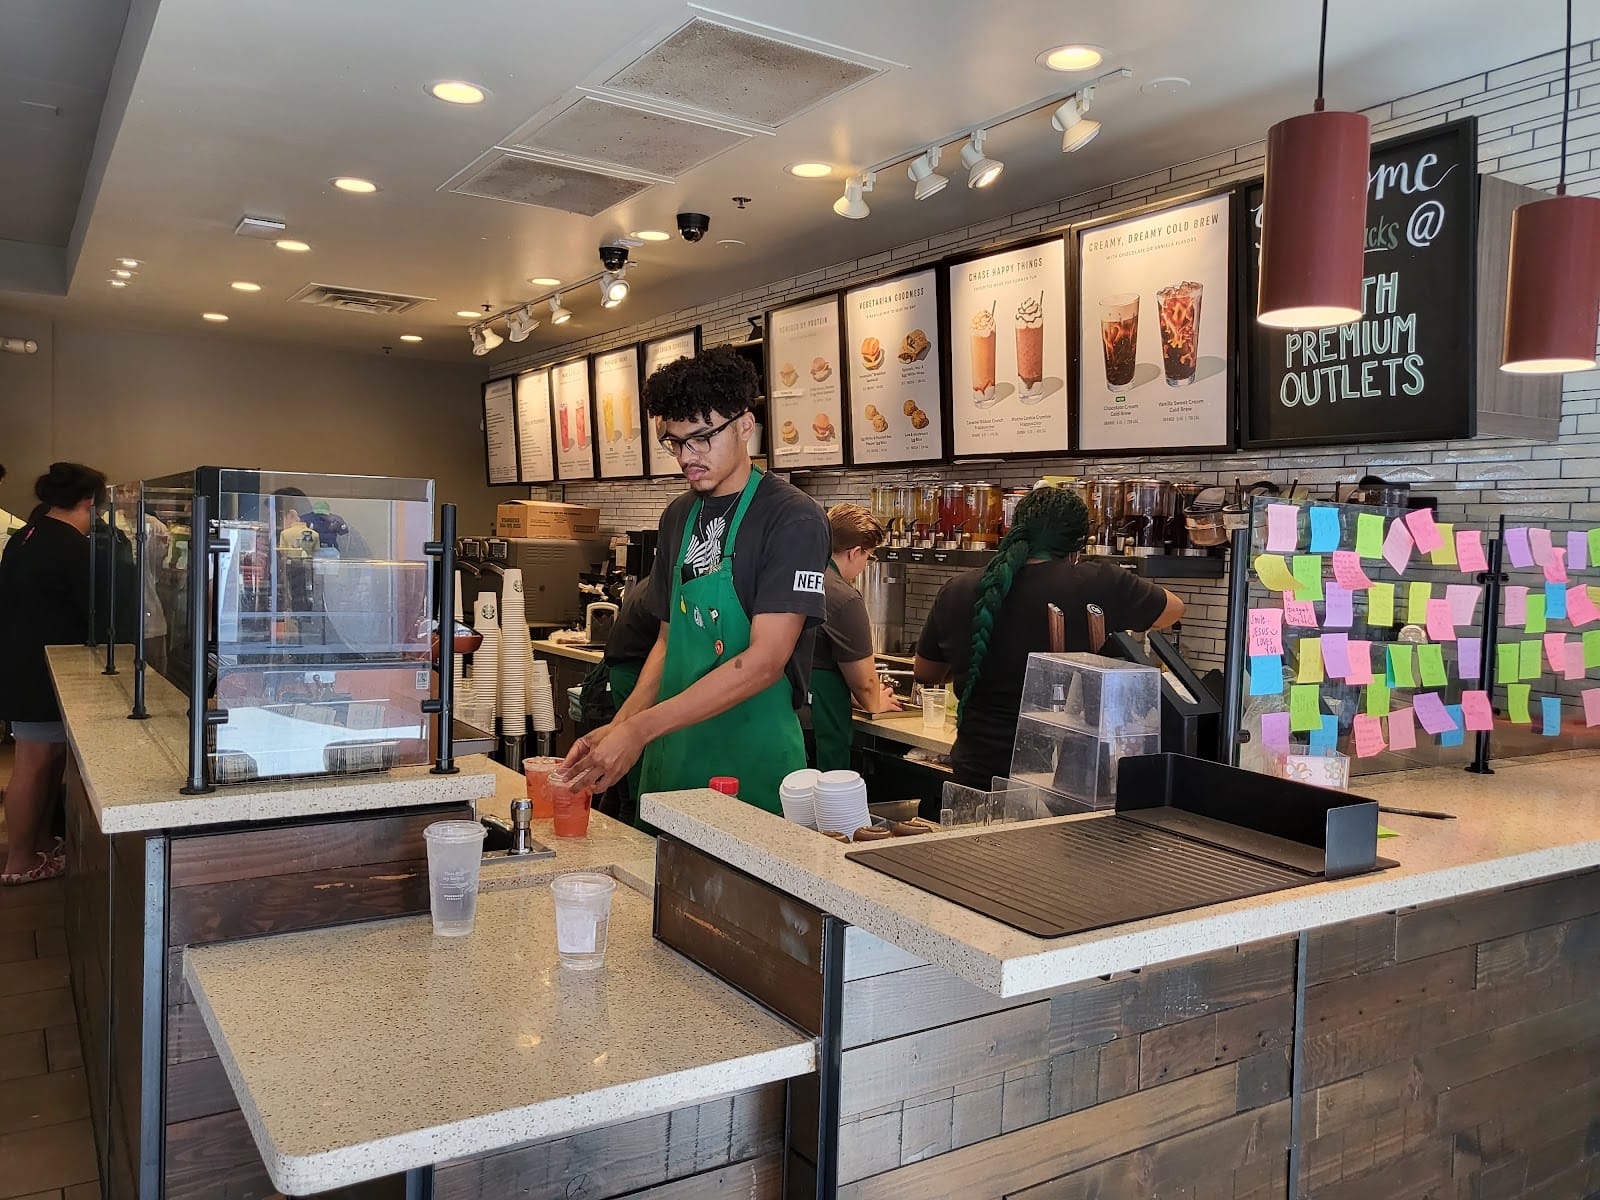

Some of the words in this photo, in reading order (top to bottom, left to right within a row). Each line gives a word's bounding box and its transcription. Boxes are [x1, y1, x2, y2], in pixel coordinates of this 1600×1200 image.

[1368, 153, 1459, 200] me
[1088, 237, 1125, 252] CREAMY,
[1128, 227, 1162, 244] DREAMY
[1166, 221, 1189, 235] COLD
[1193, 213, 1219, 229] BREW
[1406, 200, 1445, 247] @
[968, 269, 989, 282] CHASE
[992, 264, 1015, 276] HAPPY
[1017, 257, 1043, 271] THINGS
[859, 295, 892, 310] VEGETARIAN
[894, 287, 924, 302] GOODNESS
[1286, 313, 1416, 368] PREMIUM
[1280, 354, 1424, 407] OUTLETS
